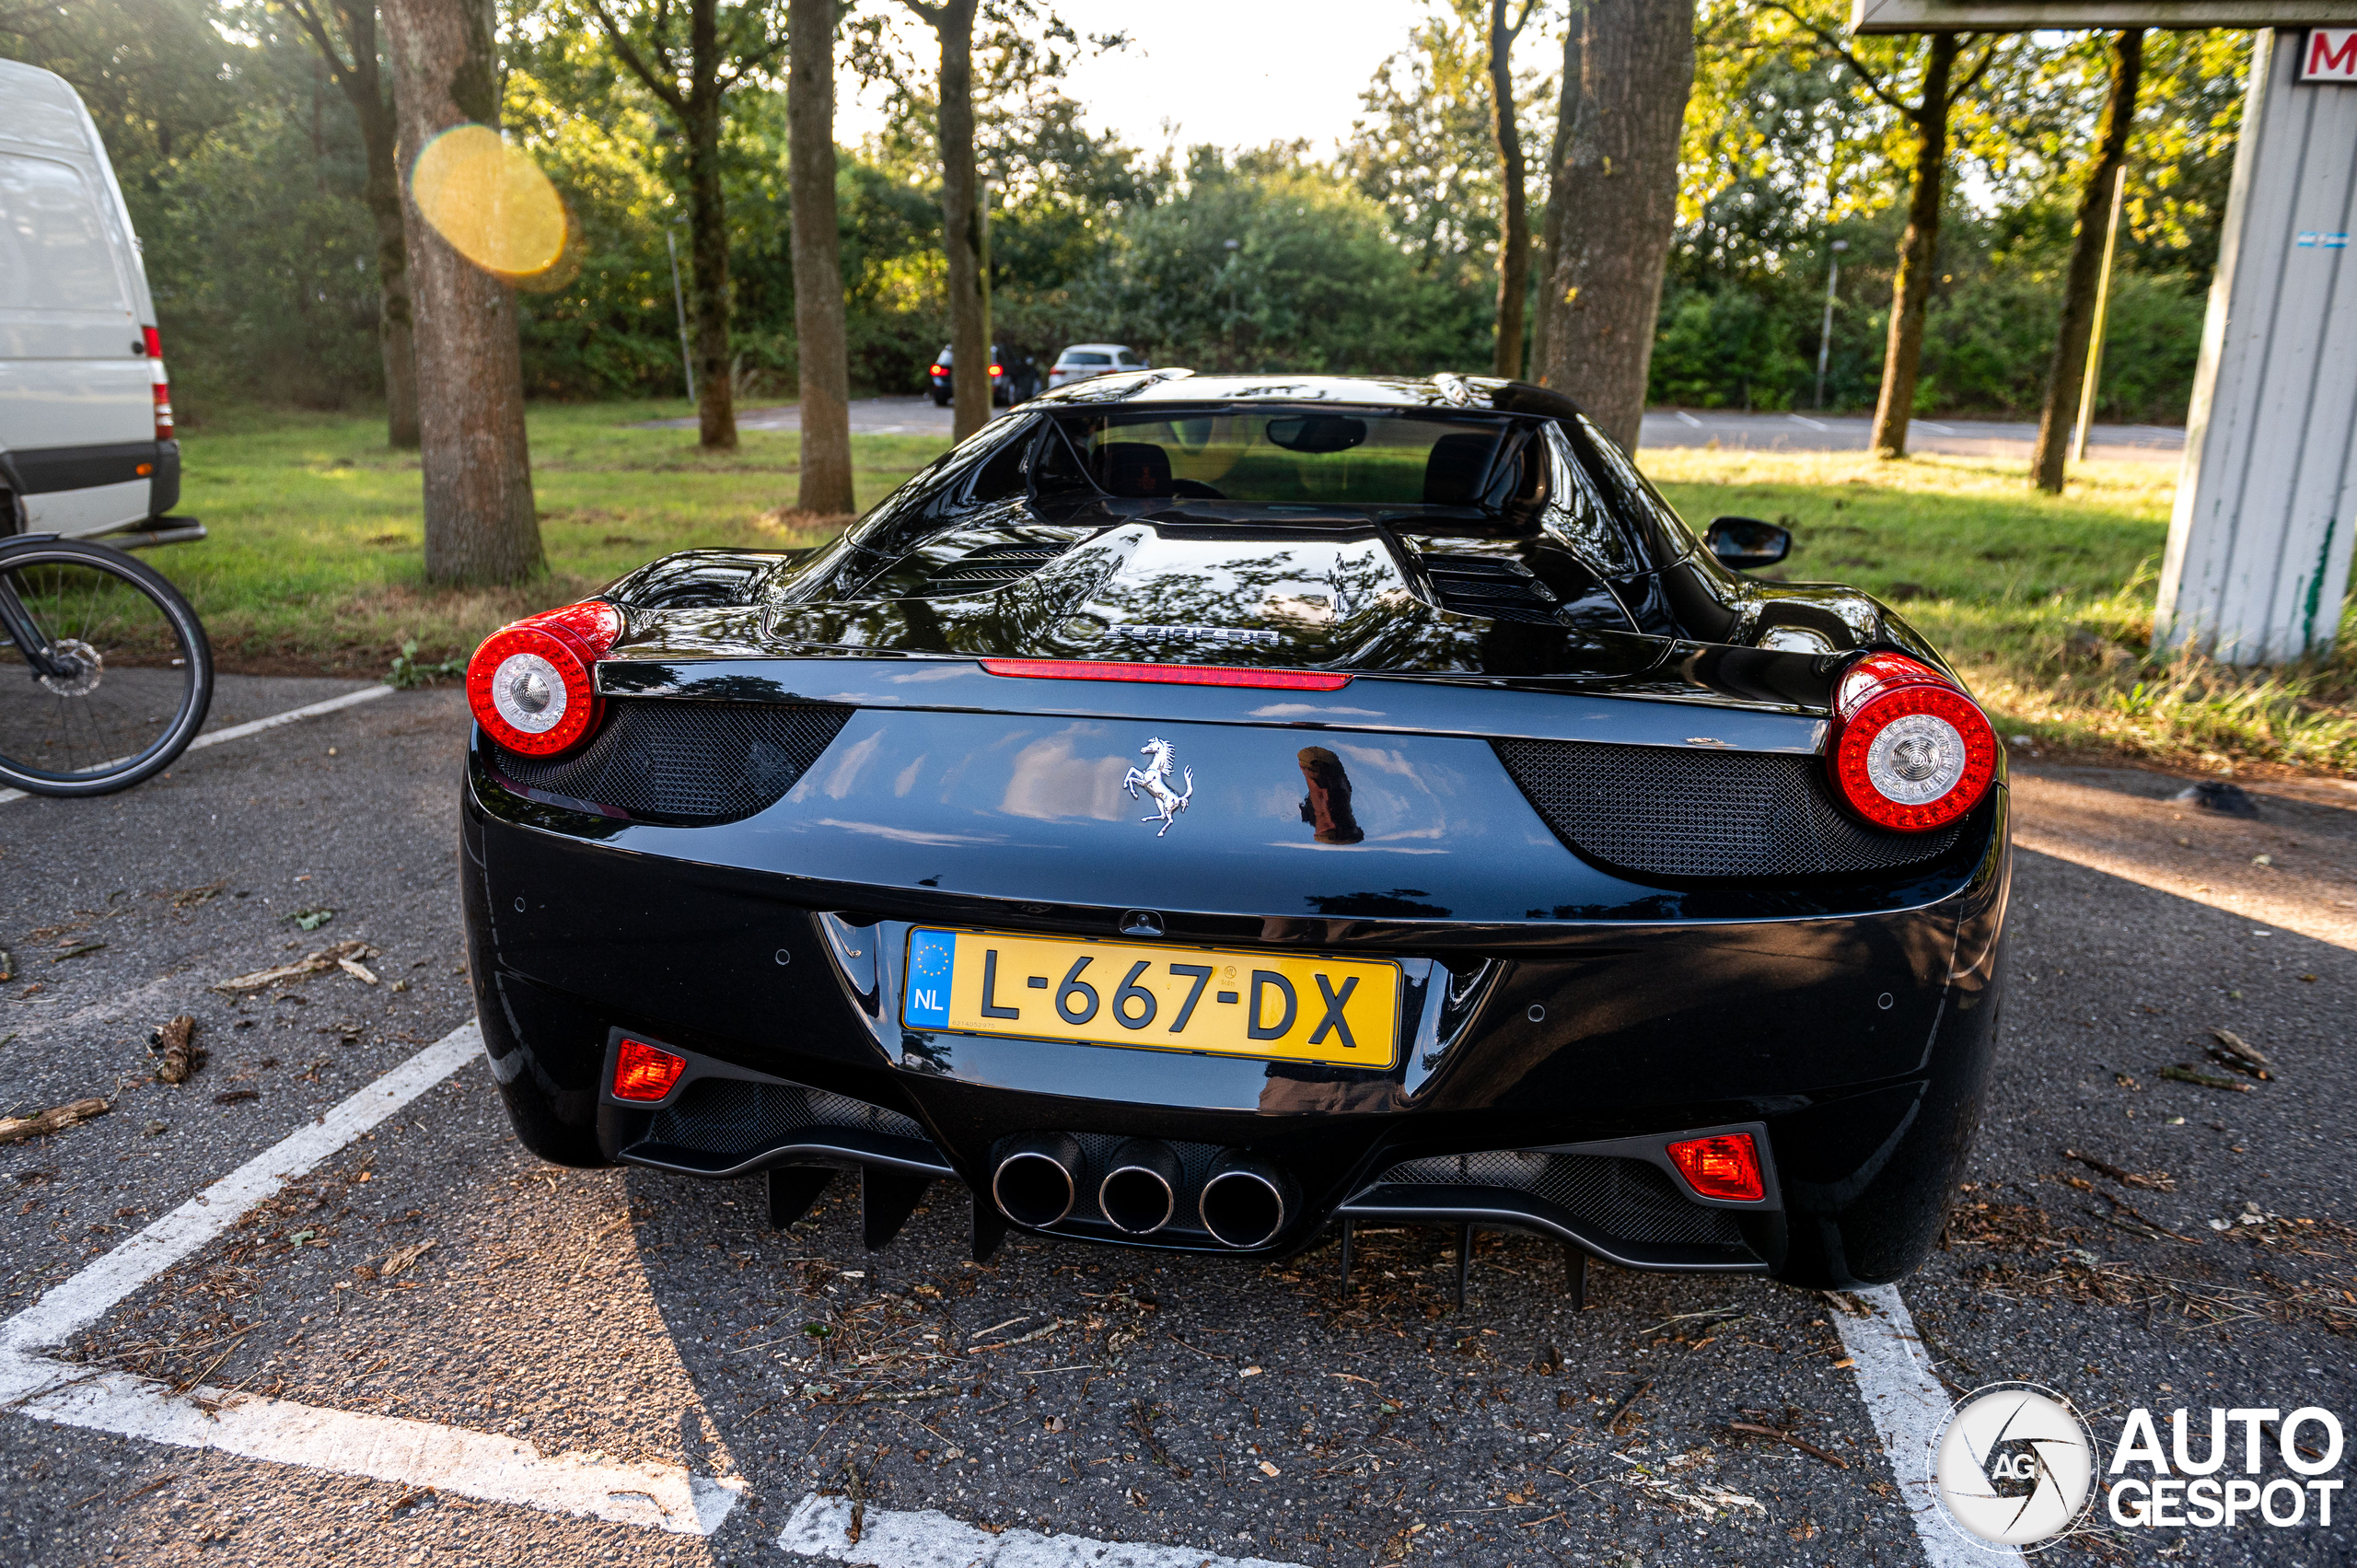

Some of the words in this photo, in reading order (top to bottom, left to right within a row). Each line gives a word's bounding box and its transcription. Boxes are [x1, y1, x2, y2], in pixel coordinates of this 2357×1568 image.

[2308, 32, 2357, 75] M
[914, 988, 944, 1011] NL
[981, 949, 1358, 1048] L-667-DX
